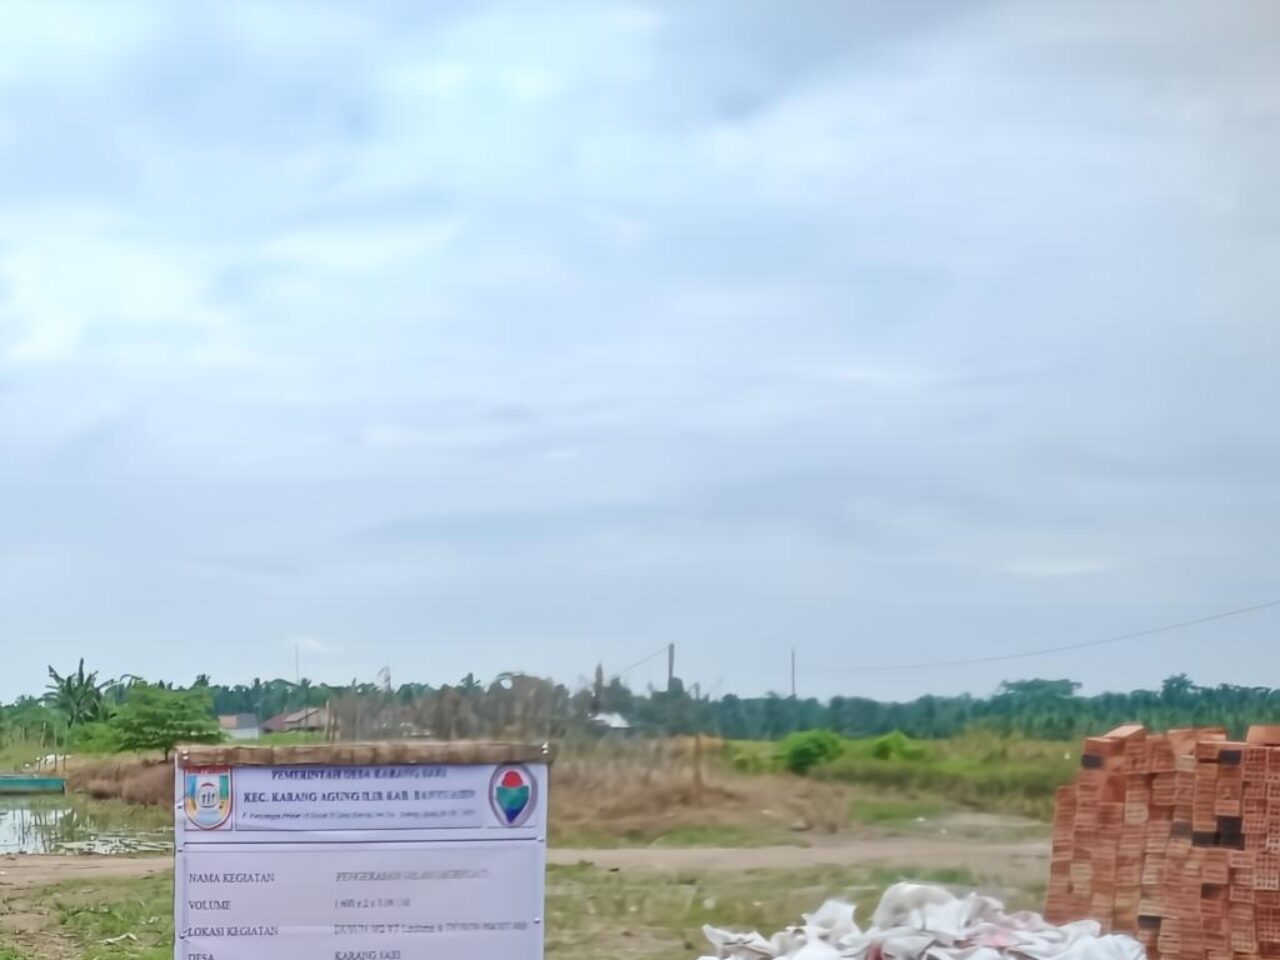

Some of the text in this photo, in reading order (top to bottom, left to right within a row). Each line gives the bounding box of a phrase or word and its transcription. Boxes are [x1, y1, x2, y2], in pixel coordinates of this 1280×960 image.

[271, 791, 318, 803] KARANG
[320, 791, 360, 802] AGUNG
[188, 873, 276, 883] NAMA KEGIATAN
[188, 900, 232, 911] VOLUME
[187, 926, 279, 937] LOKASI KEGIATAN
